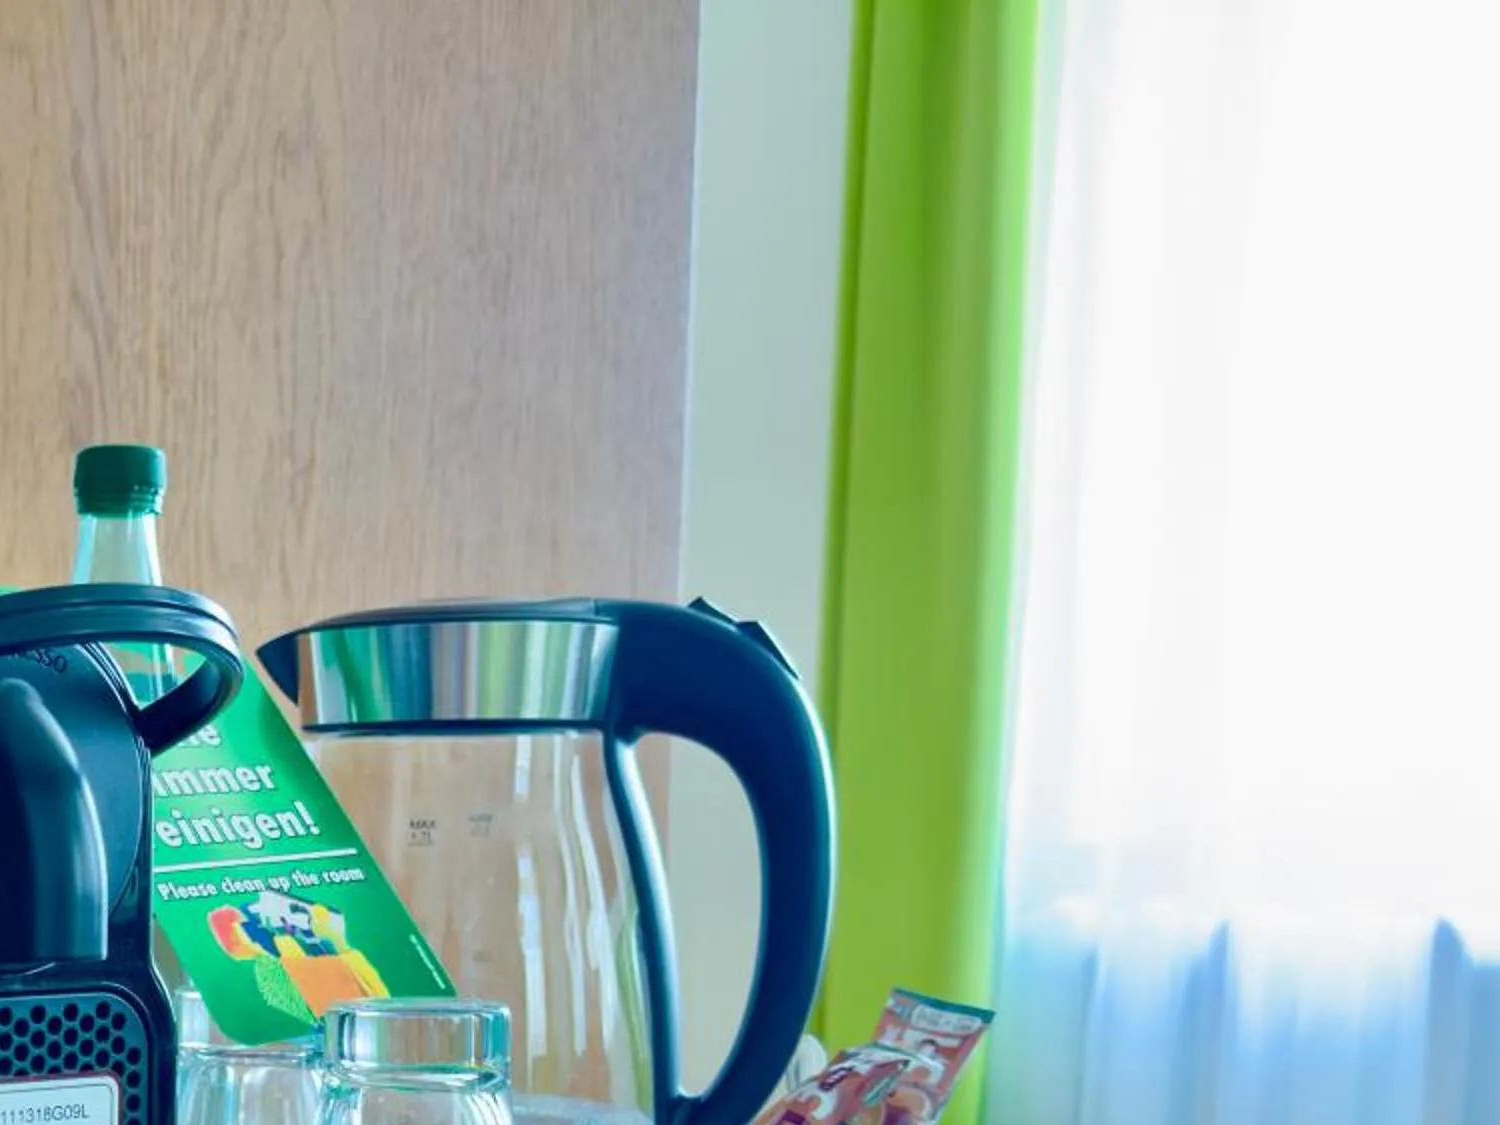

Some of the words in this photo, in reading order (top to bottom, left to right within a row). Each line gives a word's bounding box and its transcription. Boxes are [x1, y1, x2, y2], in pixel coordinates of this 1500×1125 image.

[157, 882, 218, 900] Please
[222, 876, 266, 893] clean
[268, 876, 290, 891] up
[292, 870, 320, 887] the
[322, 868, 365, 883] room
